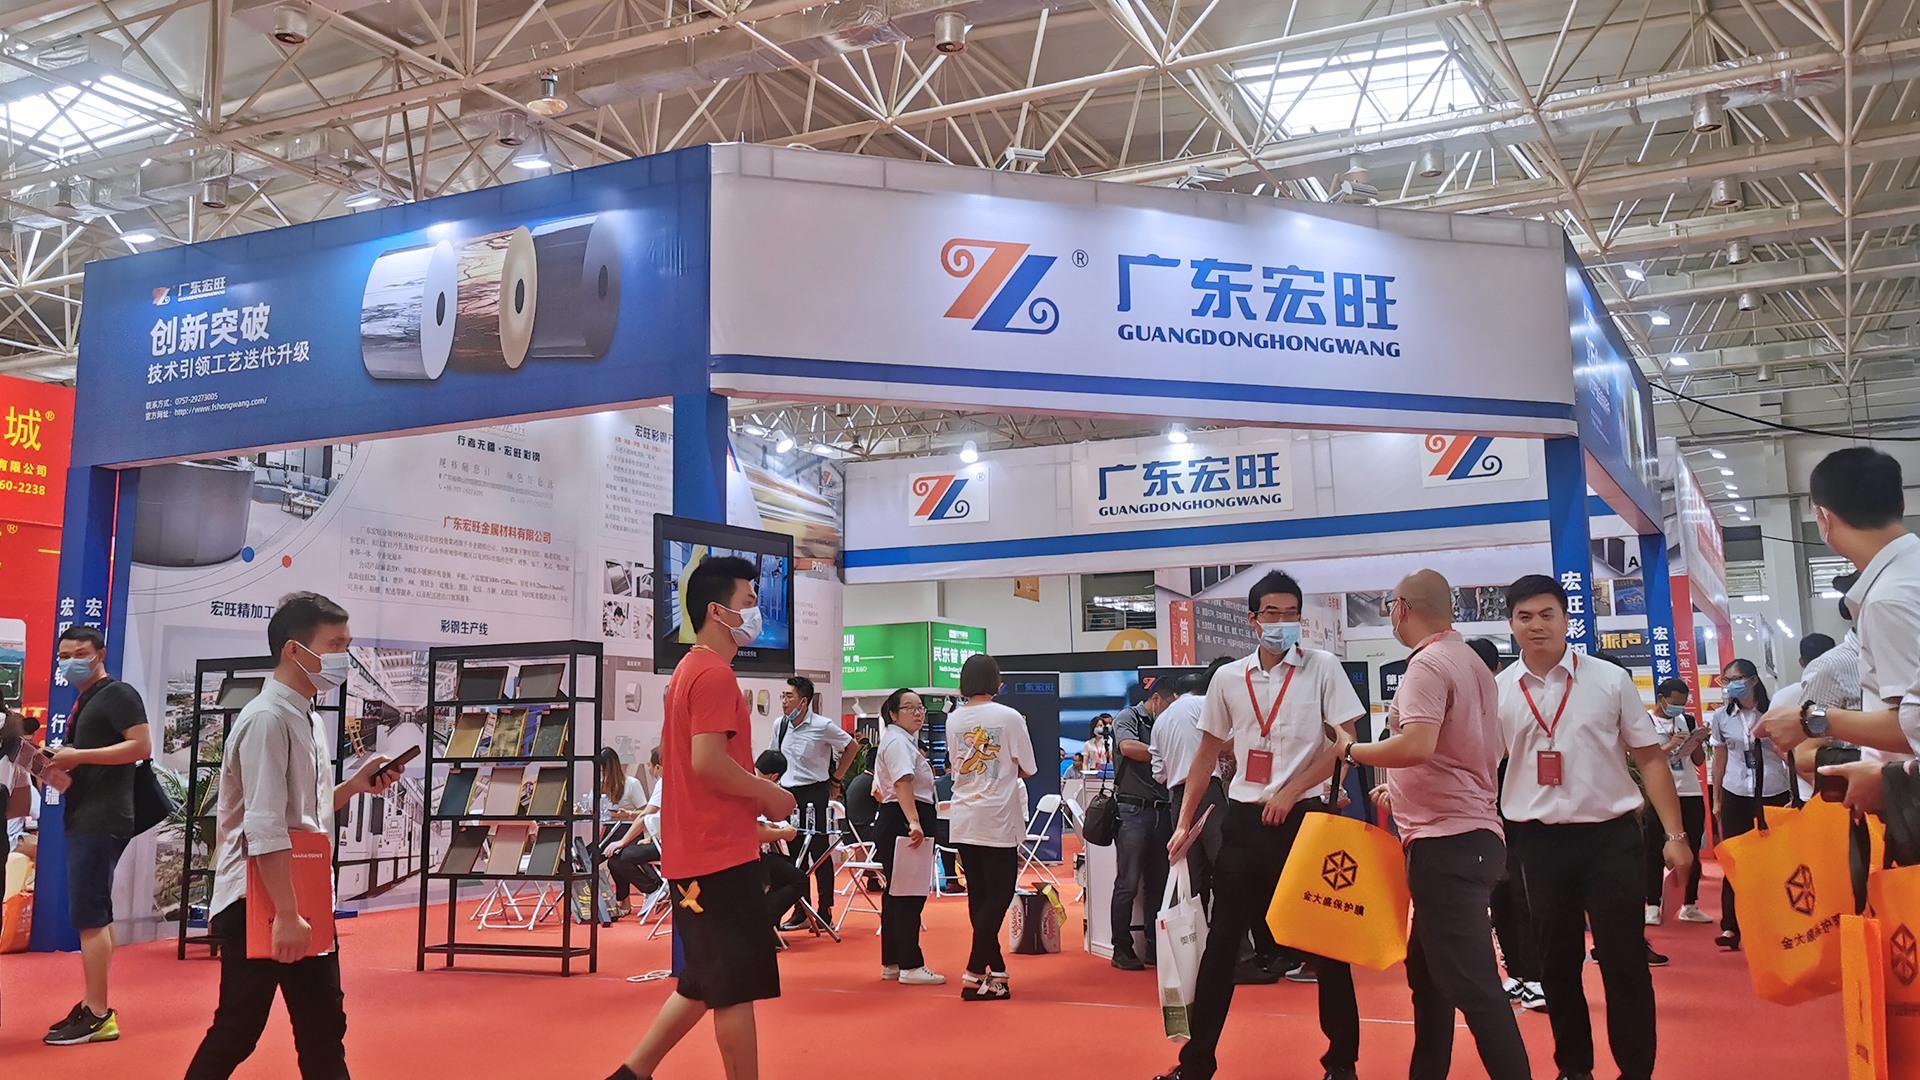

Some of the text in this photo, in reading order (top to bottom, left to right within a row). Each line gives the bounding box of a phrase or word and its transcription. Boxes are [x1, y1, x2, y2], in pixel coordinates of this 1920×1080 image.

[178, 276, 226, 297] 广东宏旺
[1117, 254, 1399, 330] 广东宏旺
[150, 302, 271, 357] 创新突破
[1118, 323, 1401, 358] GUANGDONGHONGWANG
[147, 341, 310, 384] 技术引领工艺迭代升级
[4, 406, 42, 451] 城
[0, 458, 47, 478] 有限公司
[1099, 452, 1281, 500] 广东宏旺
[0, 479, 46, 496] 60-2238
[1099, 493, 1282, 517] GUANGDONGHONGWANG
[443, 516, 551, 544] 广东宏旺金属材料有限公司
[1628, 556, 1640, 568] A
[210, 601, 275, 619] 宏旺精加工
[440, 619, 488, 636] 彩钢生产线
